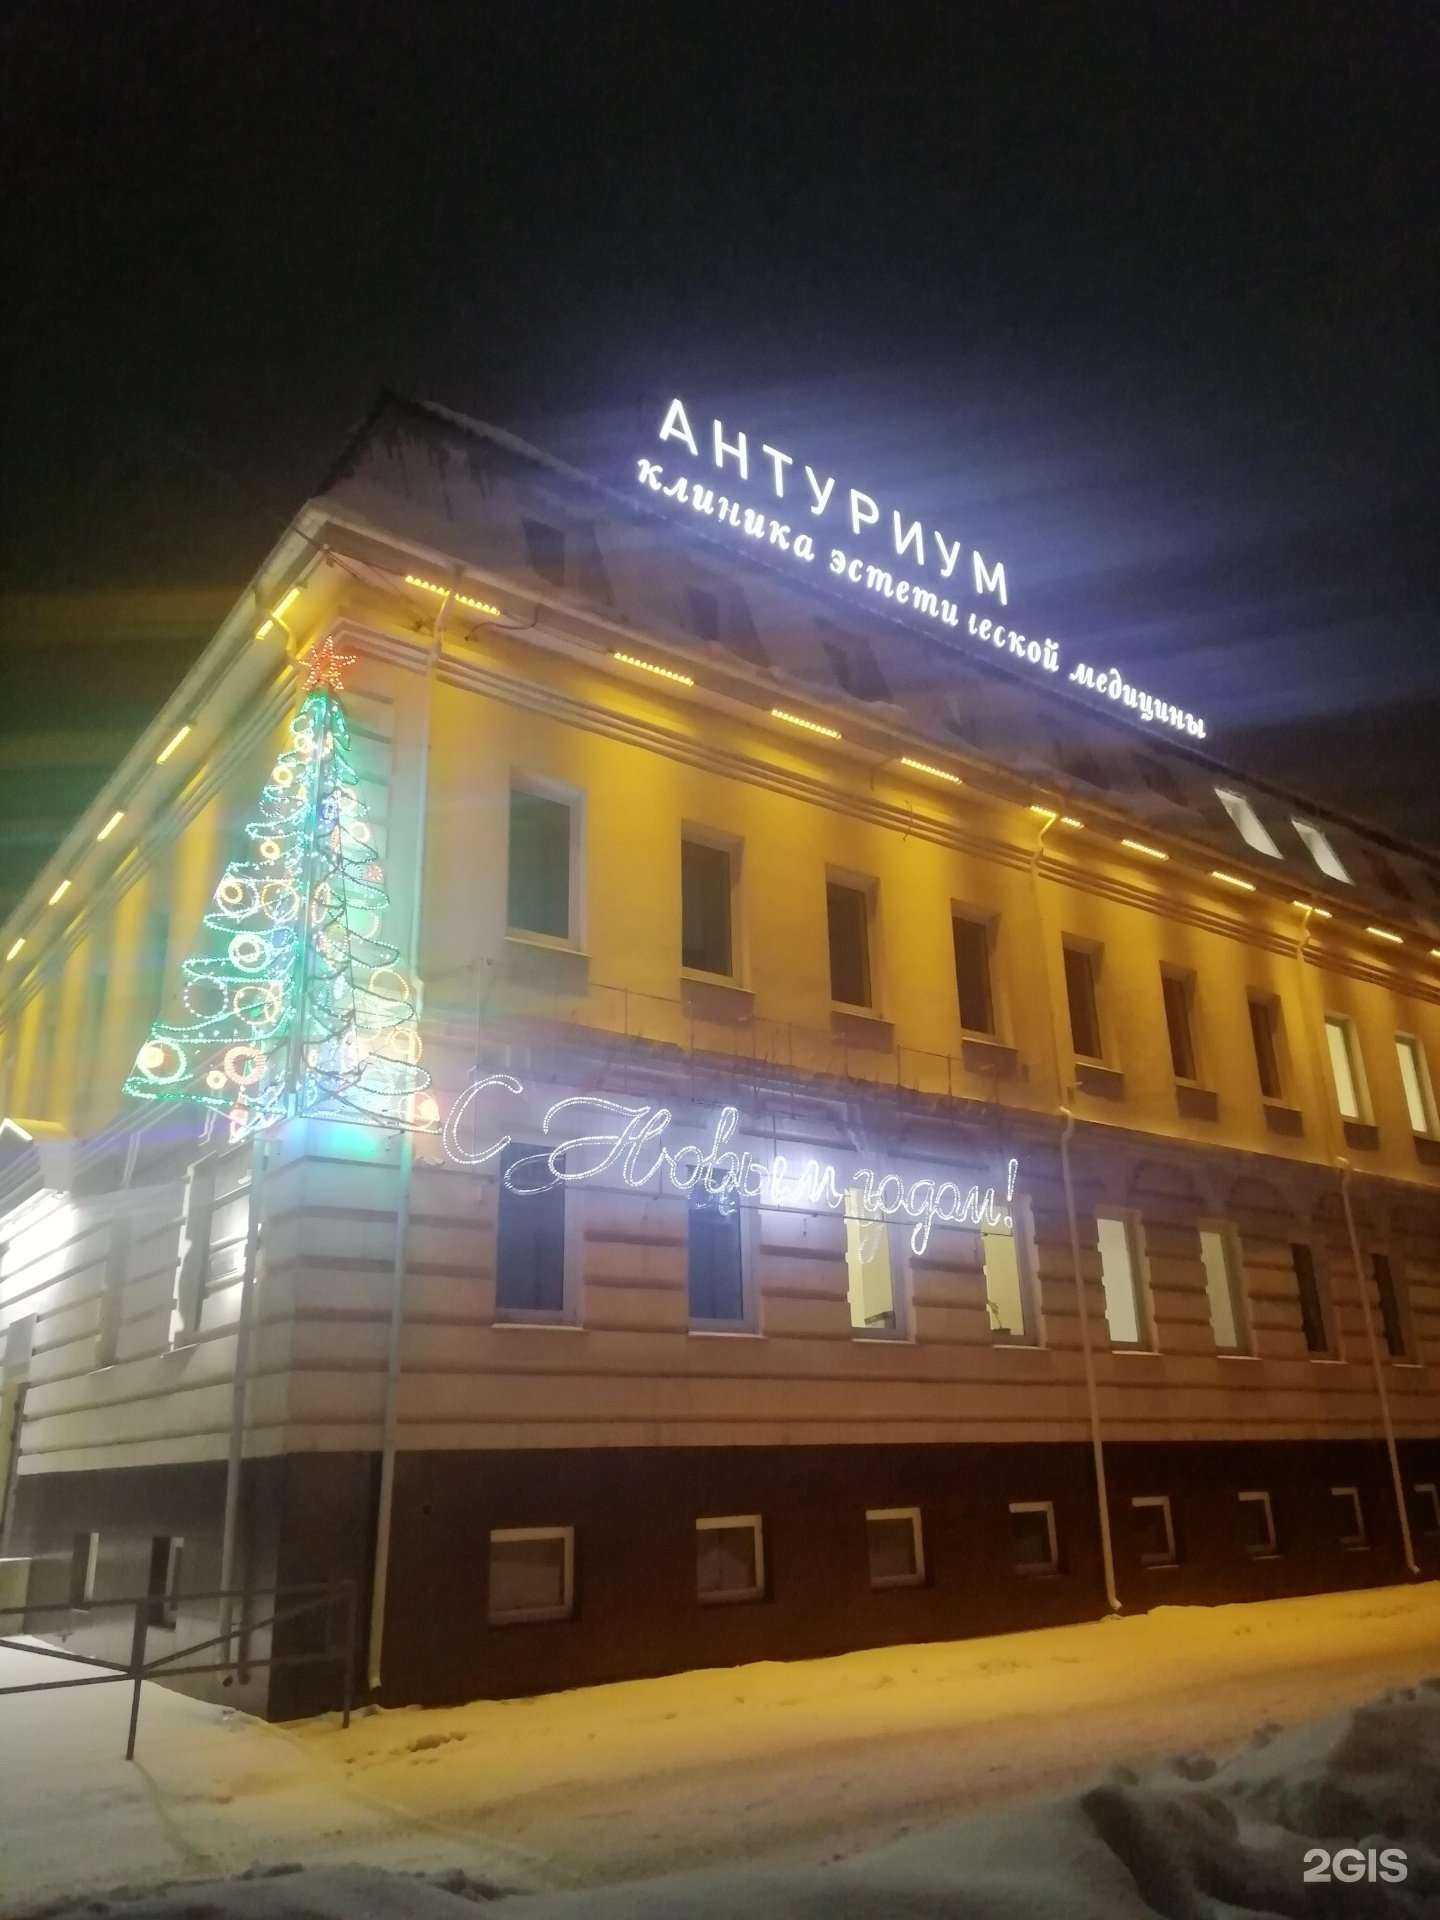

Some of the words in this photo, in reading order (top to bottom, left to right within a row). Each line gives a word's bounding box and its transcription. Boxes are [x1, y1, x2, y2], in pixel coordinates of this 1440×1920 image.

[636, 458, 816, 562] клиника
[1068, 662, 1207, 740] медицины
[659, 397, 1009, 606] АНТУРИУМ
[442, 1073, 524, 1165] С
[543, 1096, 846, 1208] Новым
[852, 1158, 1019, 1256] годом!
